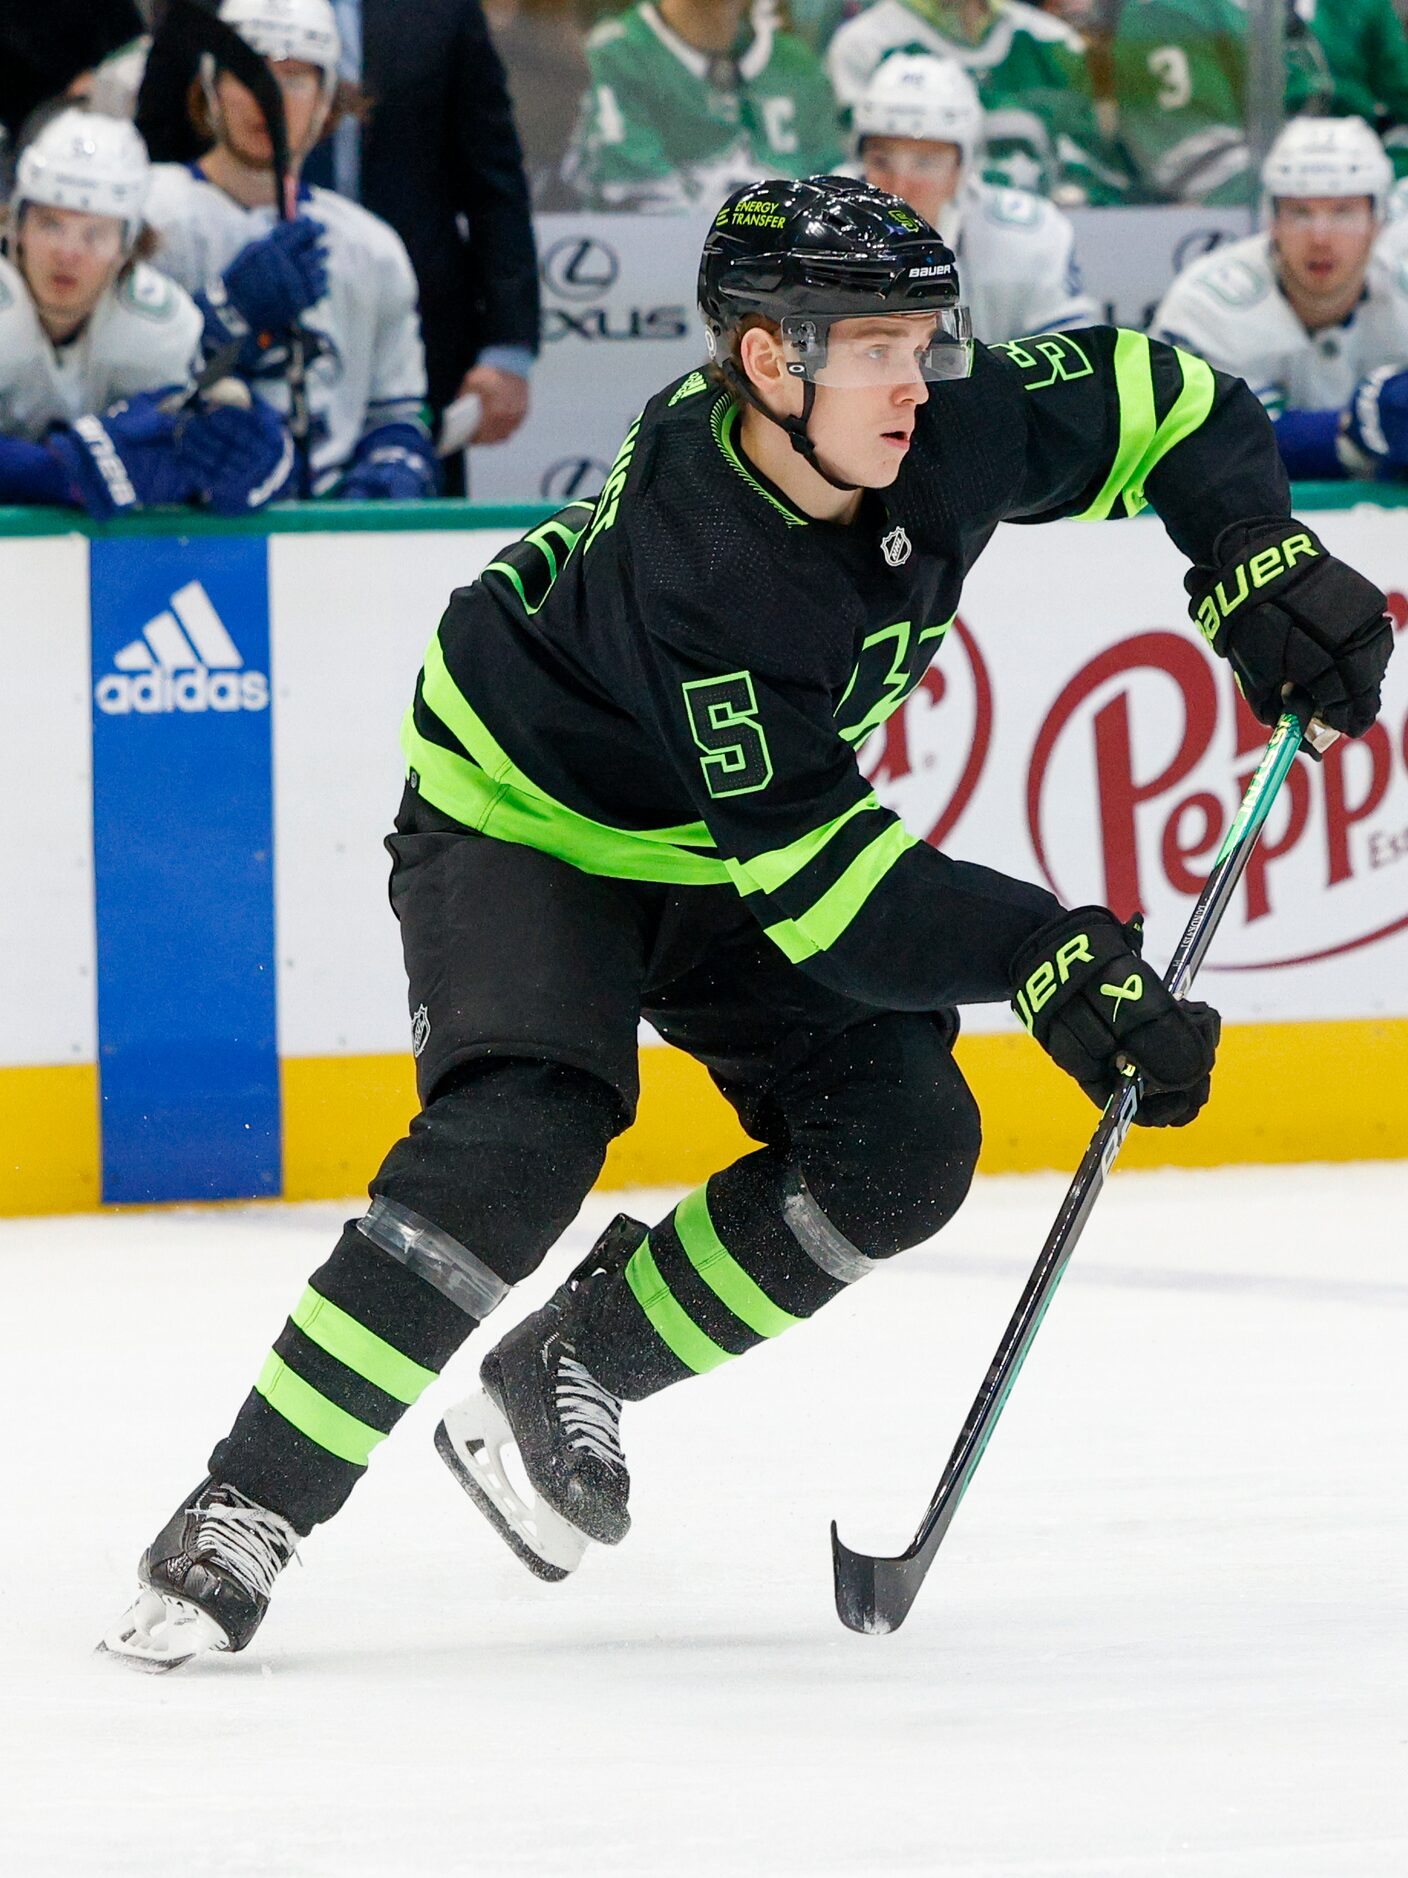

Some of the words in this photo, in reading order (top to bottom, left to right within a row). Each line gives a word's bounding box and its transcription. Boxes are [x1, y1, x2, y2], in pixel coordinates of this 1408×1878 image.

[1147, 47, 1190, 112] 3
[762, 96, 797, 153] C
[731, 213, 787, 230] TRANSFER
[734, 201, 779, 214] ENERGY
[908, 263, 951, 279] BAUER
[541, 306, 688, 343] XUS
[1194, 533, 1319, 649] AUER
[96, 665, 270, 714] adidas
[682, 671, 773, 799] 5
[1013, 933, 1095, 1037] UER
